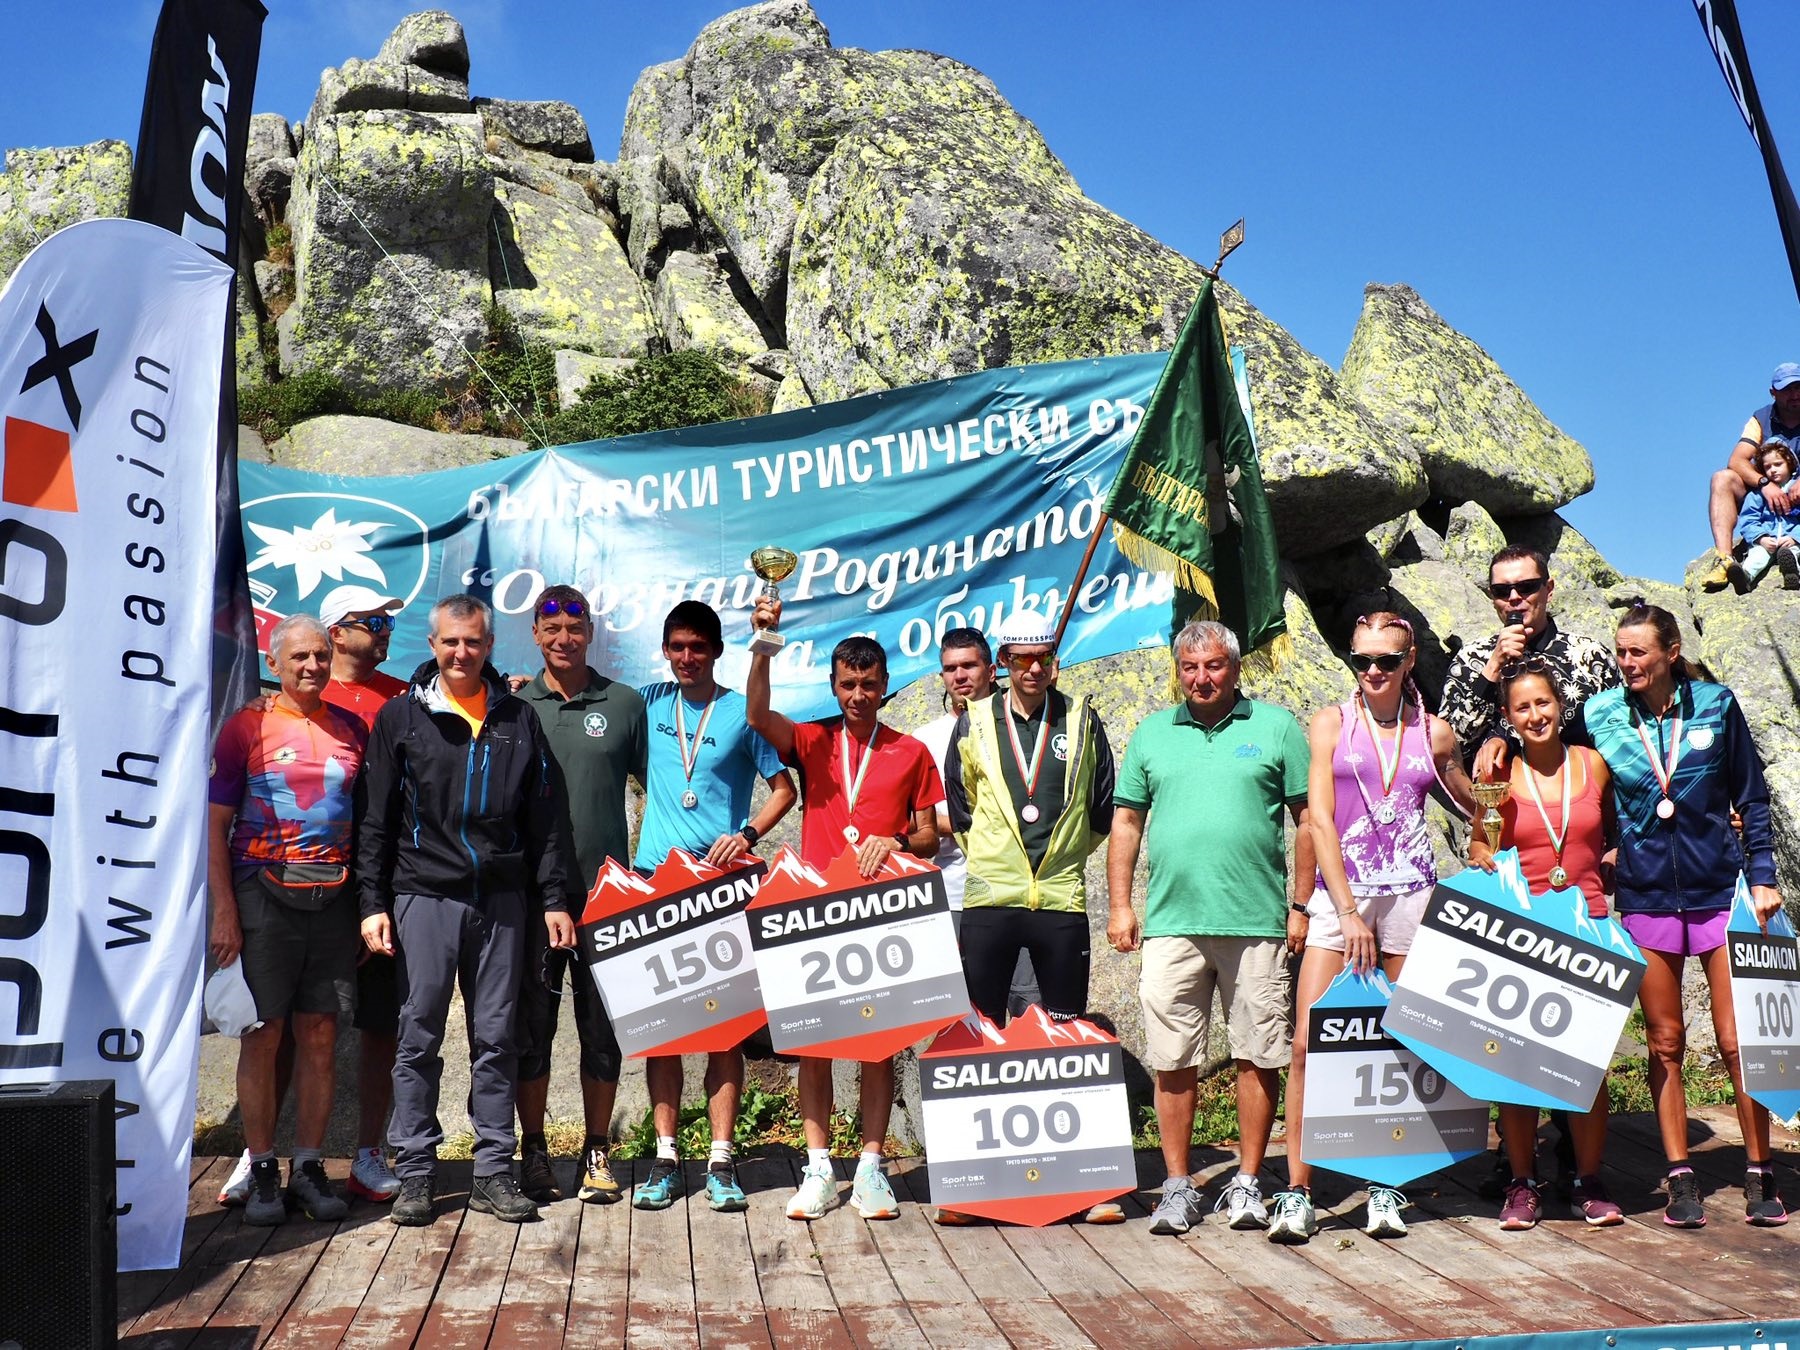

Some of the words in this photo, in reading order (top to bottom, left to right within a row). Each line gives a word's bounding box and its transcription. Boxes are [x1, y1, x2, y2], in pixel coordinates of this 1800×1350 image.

[467, 465, 718, 521] БЪЛГАРСКИ
[732, 405, 1070, 501] ТУРИСТИЧЕСКИ
[1089, 393, 1150, 436] СЪ
[117, 355, 176, 687] passion
[97, 751, 160, 949] with
[594, 874, 760, 952] SALOMON
[761, 882, 933, 939] SALOMON
[644, 931, 743, 996] 150
[800, 935, 913, 995] 200
[1437, 899, 1630, 991] SALOMON
[1734, 942, 1797, 971] SALOMON
[1400, 1005, 1426, 1020] Sport
[1445, 958, 1573, 1038] 200
[1755, 992, 1793, 1037] 100
[627, 1023, 649, 1036] Sport
[781, 1020, 804, 1030] Sport
[1319, 1016, 1392, 1042] SAL
[932, 1053, 1110, 1090] SALOMON
[1354, 1062, 1446, 1107] 150
[1539, 1065, 1581, 1087] www.sportbox.bg
[973, 1101, 1081, 1150] 100
[1313, 1132, 1336, 1140] Sport
[941, 1176, 966, 1184] Sport
